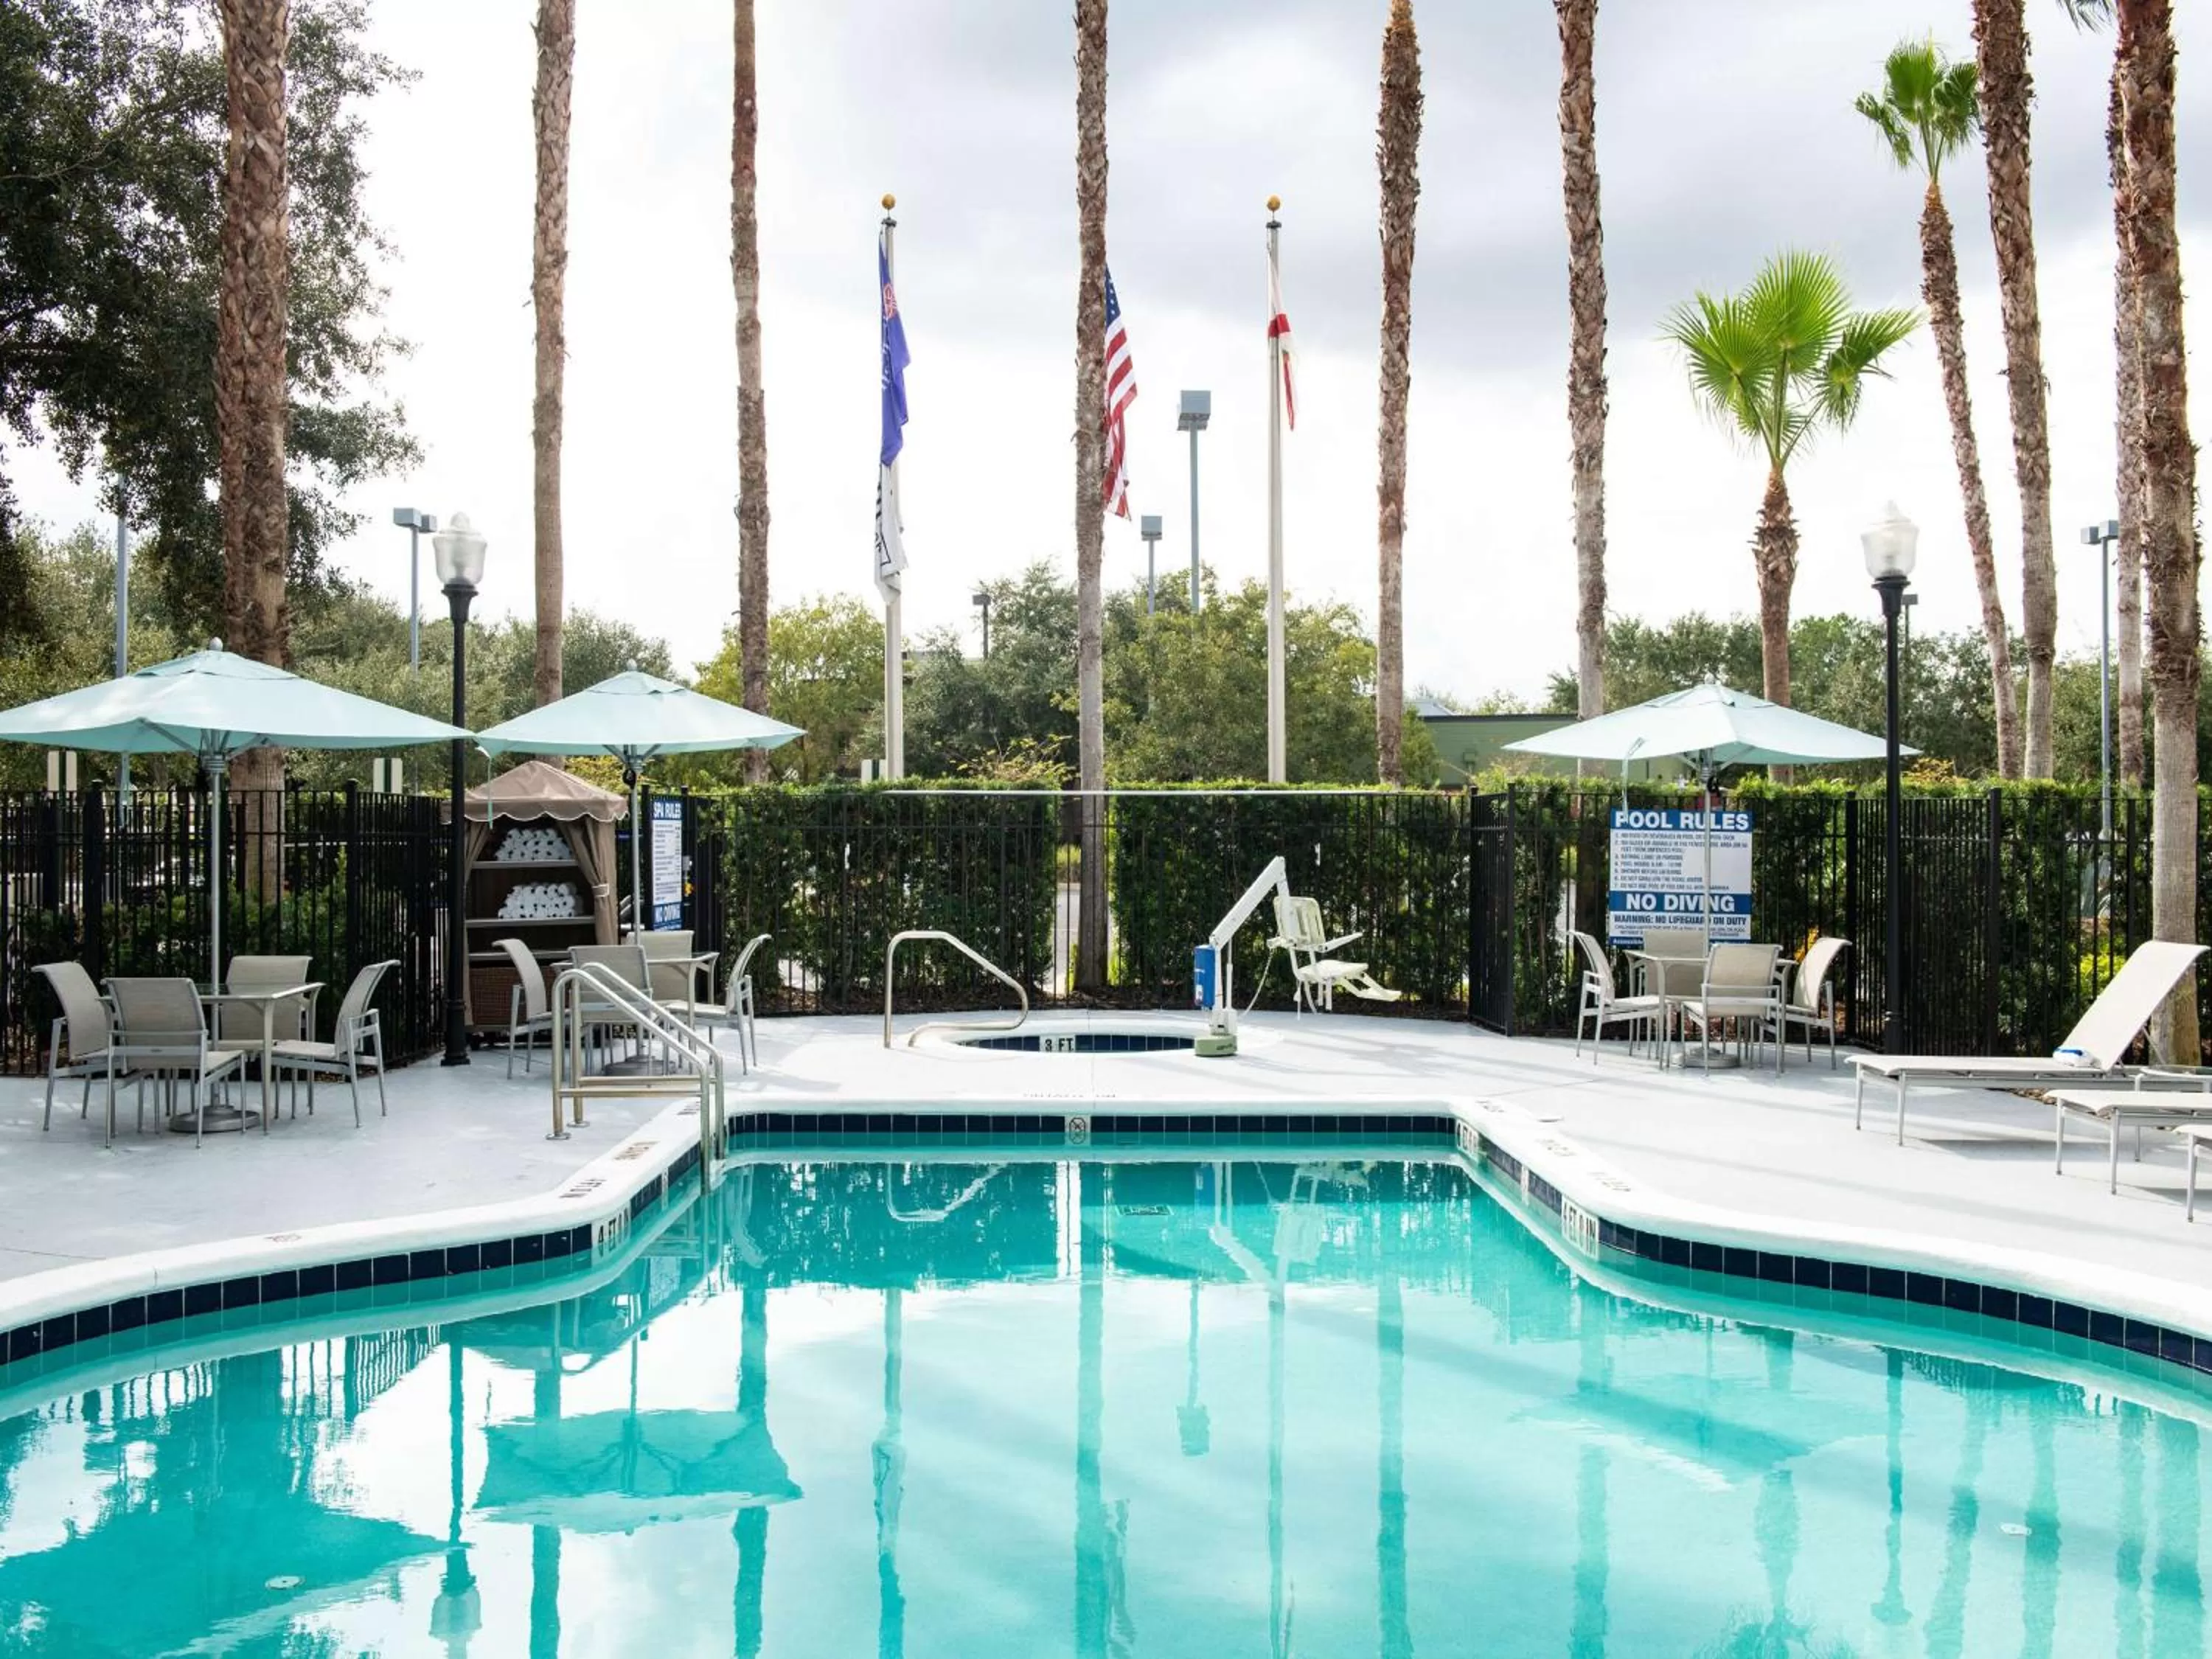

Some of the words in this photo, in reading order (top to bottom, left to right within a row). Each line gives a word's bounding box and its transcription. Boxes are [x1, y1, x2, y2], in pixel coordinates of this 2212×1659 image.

[653, 802, 664, 818] SPA
[665, 802, 681, 818] RULES
[1615, 811, 1673, 829] POOL
[1680, 813, 1750, 830] RULES
[1626, 893, 1657, 911] NO
[1664, 894, 1735, 912] DIVING
[1614, 914, 1653, 924] WARNING:
[1655, 915, 1666, 924] NO
[1669, 916, 1711, 925] LIFEGUAR
[1713, 917, 1725, 925] ON
[1727, 917, 1747, 925] DUTY
[1045, 1038, 1052, 1052] 3
